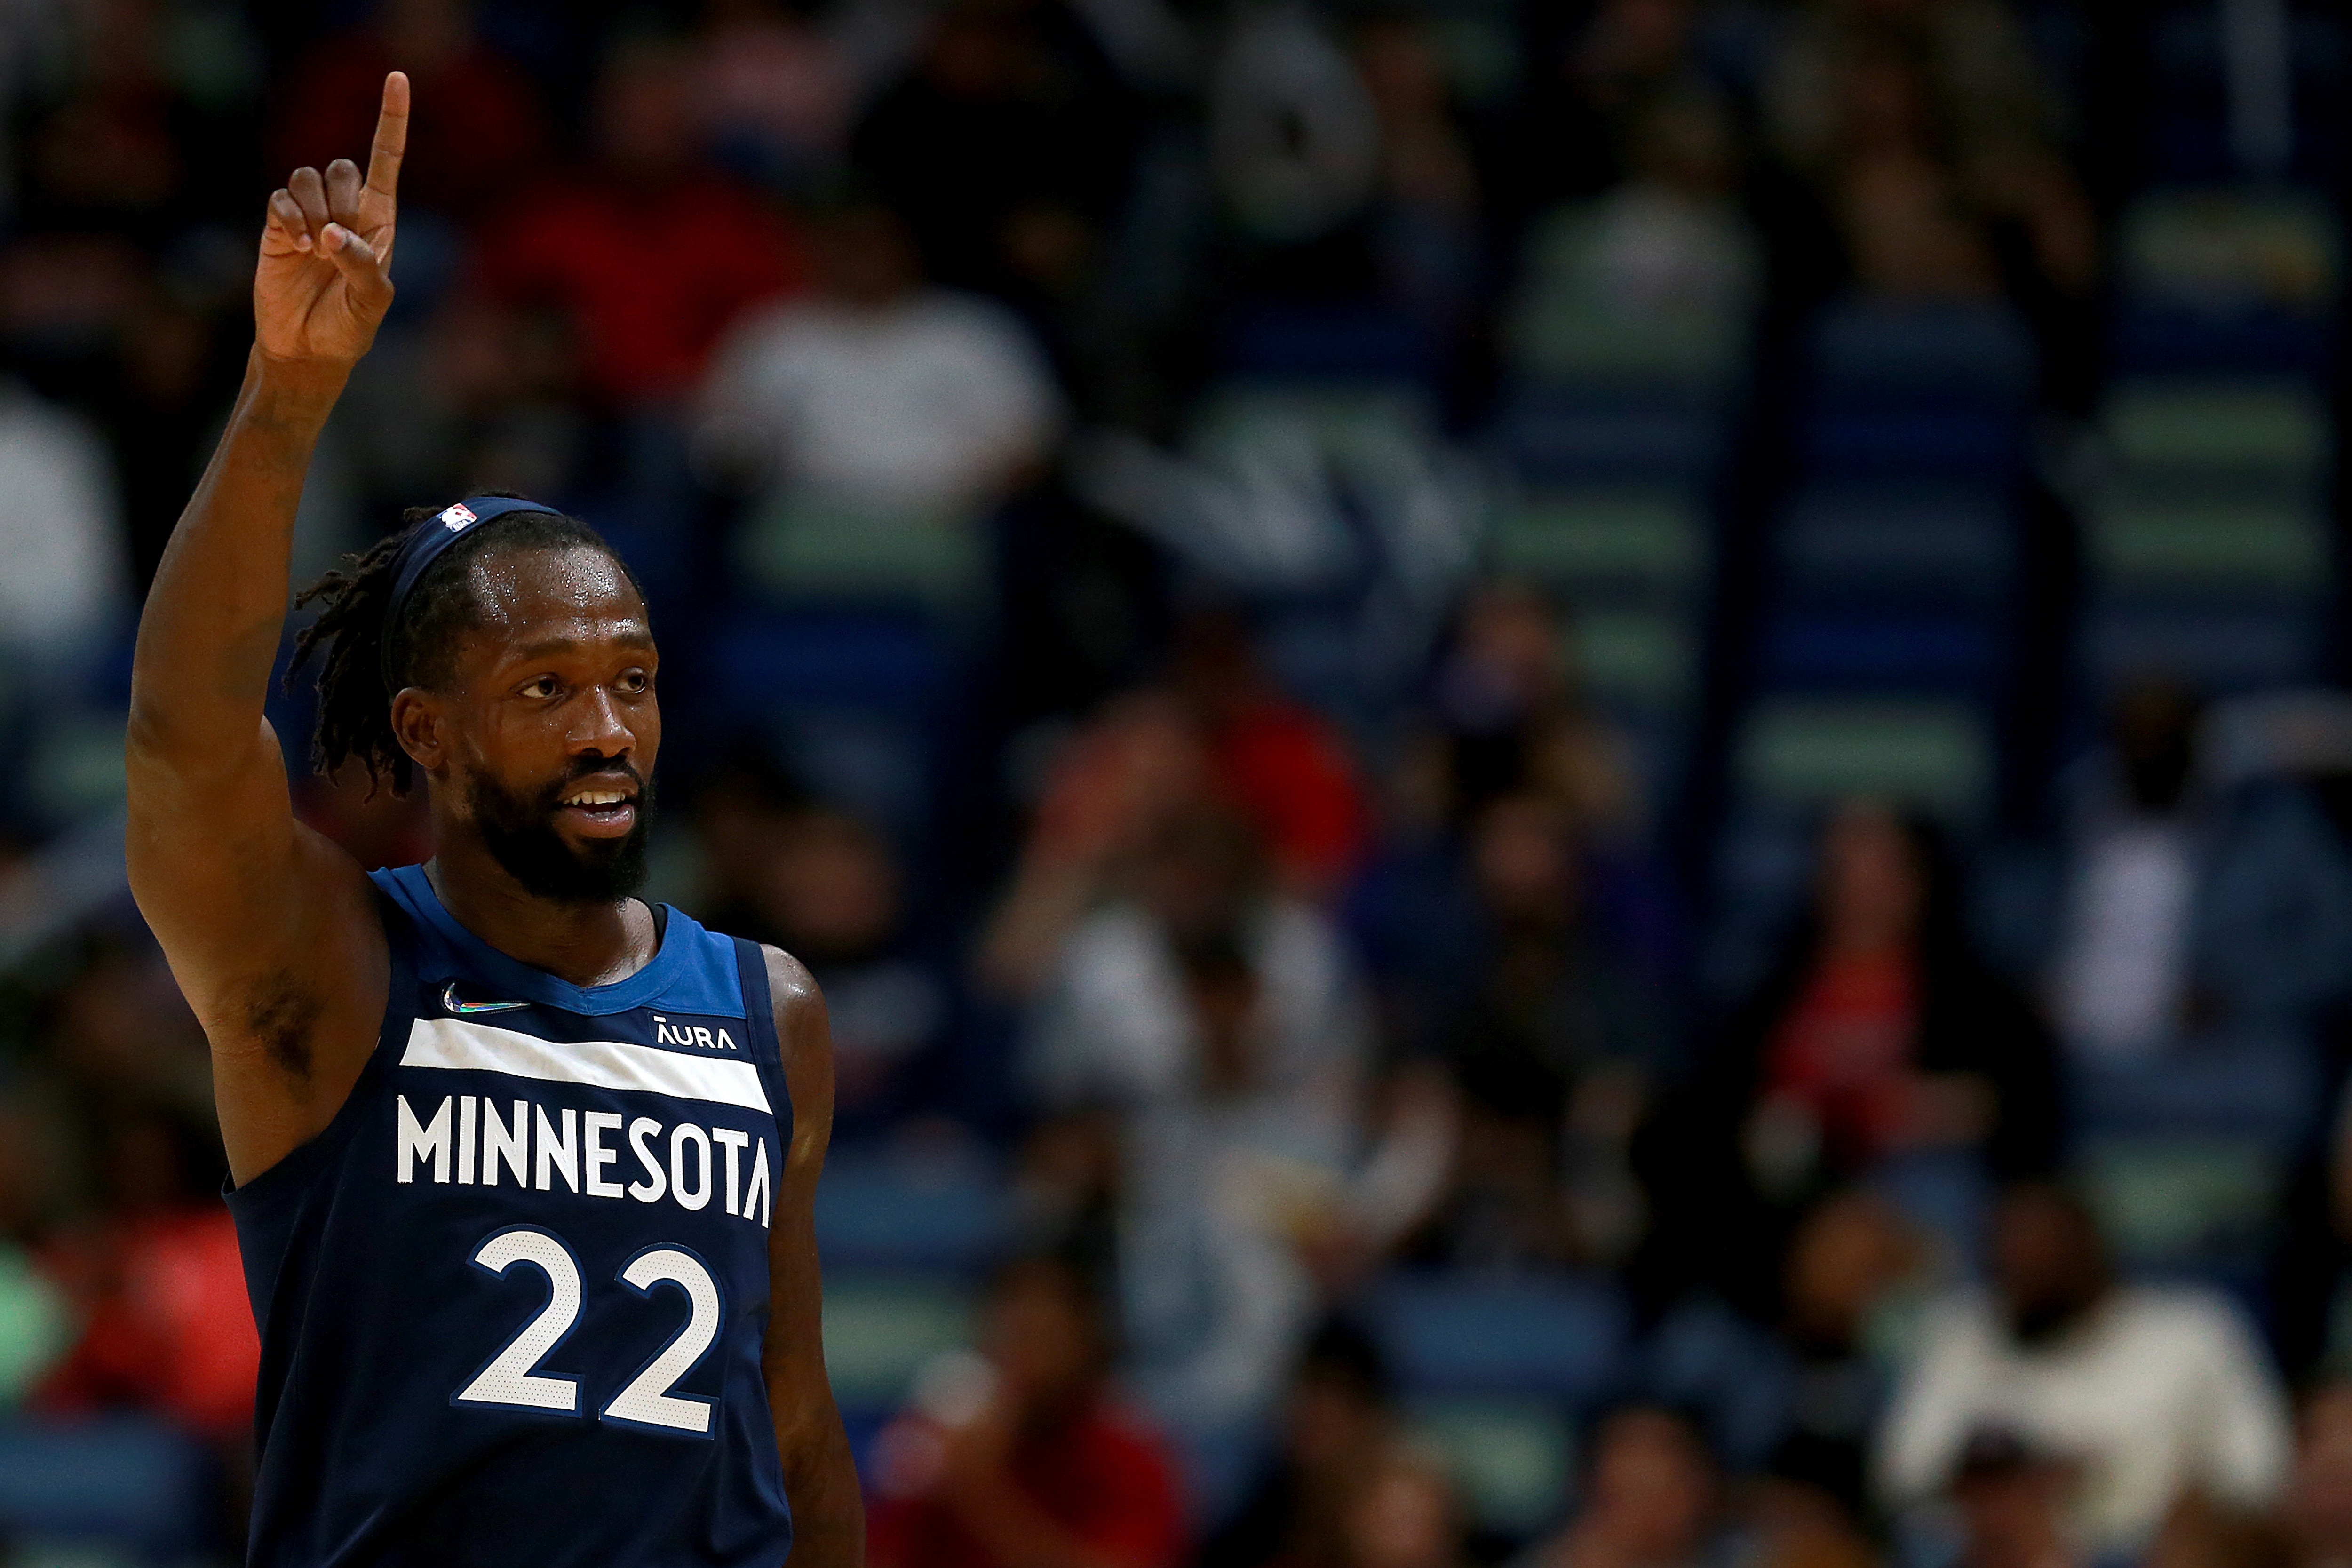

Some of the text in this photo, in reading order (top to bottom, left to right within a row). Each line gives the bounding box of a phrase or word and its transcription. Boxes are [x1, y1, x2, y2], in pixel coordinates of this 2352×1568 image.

[452, 519, 469, 530] NBA
[397, 1094, 771, 1229] MINNESOTA
[456, 1229, 721, 1433] 22
